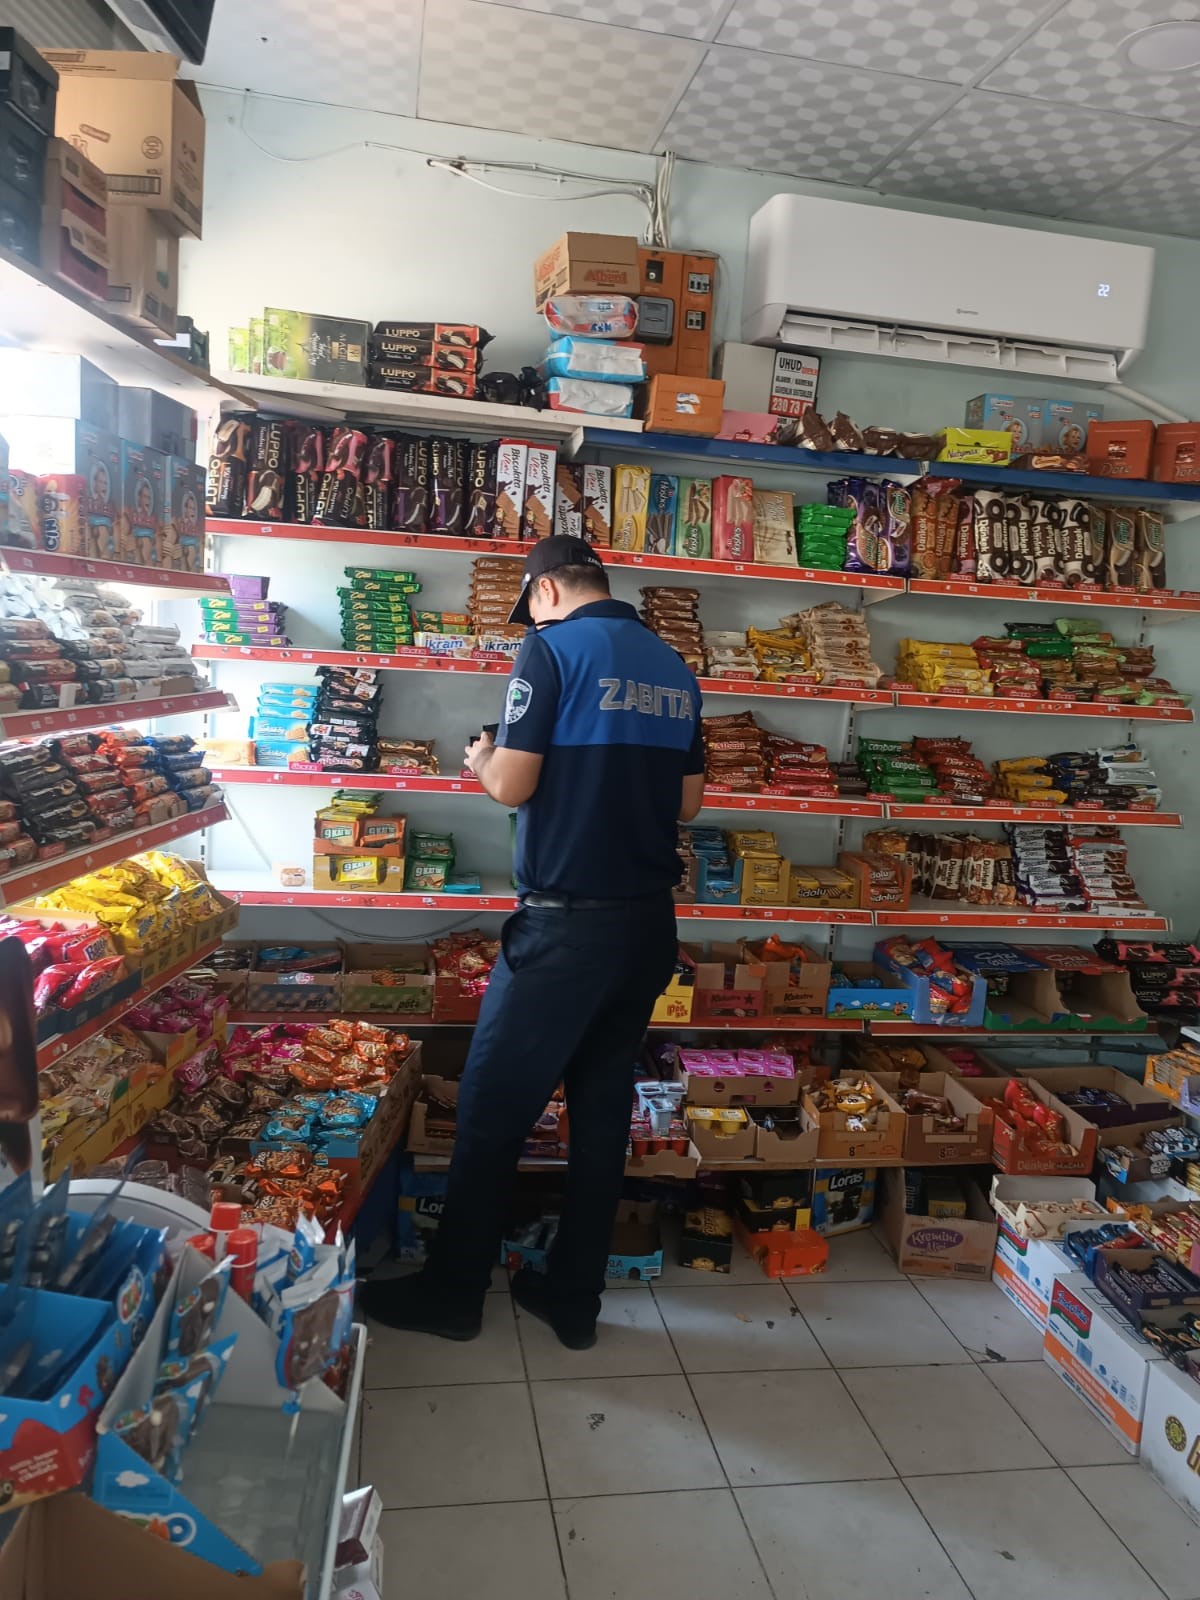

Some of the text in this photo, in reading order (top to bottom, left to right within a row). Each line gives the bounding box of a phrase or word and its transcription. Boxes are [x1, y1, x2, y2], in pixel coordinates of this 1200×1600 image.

[1098, 284, 1110, 296] 22
[385, 328, 421, 338] LUPPO
[382, 342, 417, 353] LUPPO
[380, 368, 416, 379] LUPPO
[780, 357, 802, 371] UHUD
[268, 422, 282, 469] LUPPO
[511, 448, 521, 489] Biscolata
[539, 452, 550, 494] Biscolata
[206, 459, 221, 505] LUPPO
[960, 525, 969, 558] Dankek
[979, 520, 990, 552] Dankek
[1018, 522, 1030, 554] Dankek
[1032, 526, 1043, 556] Dankek
[1074, 528, 1084, 559] Dankek
[425, 638, 463, 650] ikram
[484, 640, 522, 652] ikram
[599, 678, 693, 720] ZABITA
[830, 1172, 864, 1190] Loras
[418, 1198, 445, 1214] Lor
[912, 1231, 958, 1245] Kremini
